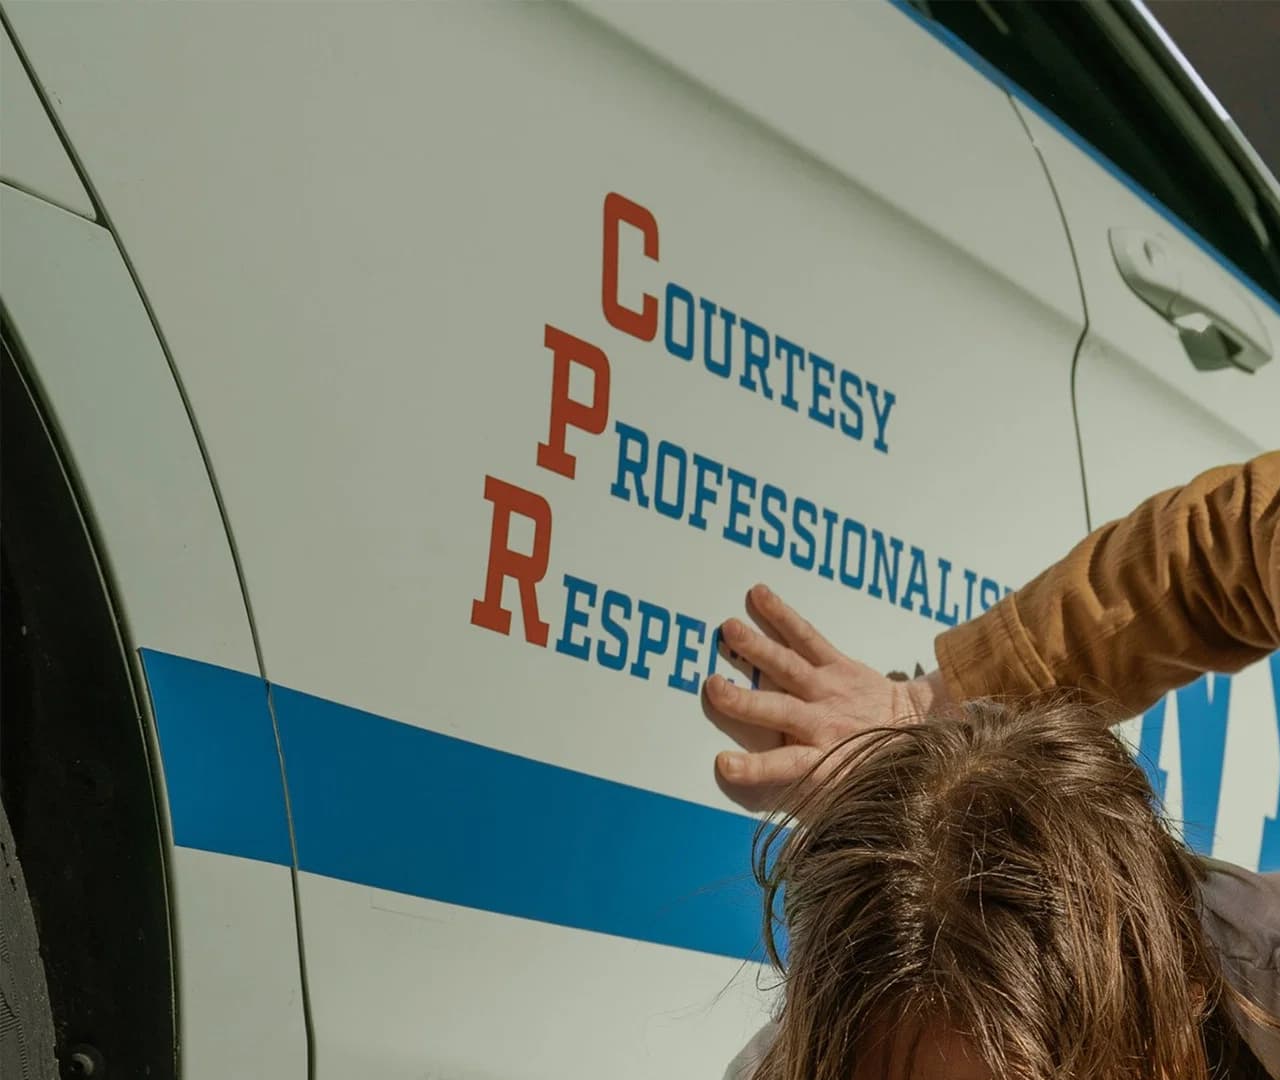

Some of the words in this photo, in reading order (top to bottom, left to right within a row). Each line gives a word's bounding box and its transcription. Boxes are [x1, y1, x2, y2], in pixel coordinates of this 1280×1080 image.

[602, 192, 896, 454] COURTESY
[470, 474, 760, 696] RESPE
[537, 323, 1013, 627] PROFESSIONALIS
